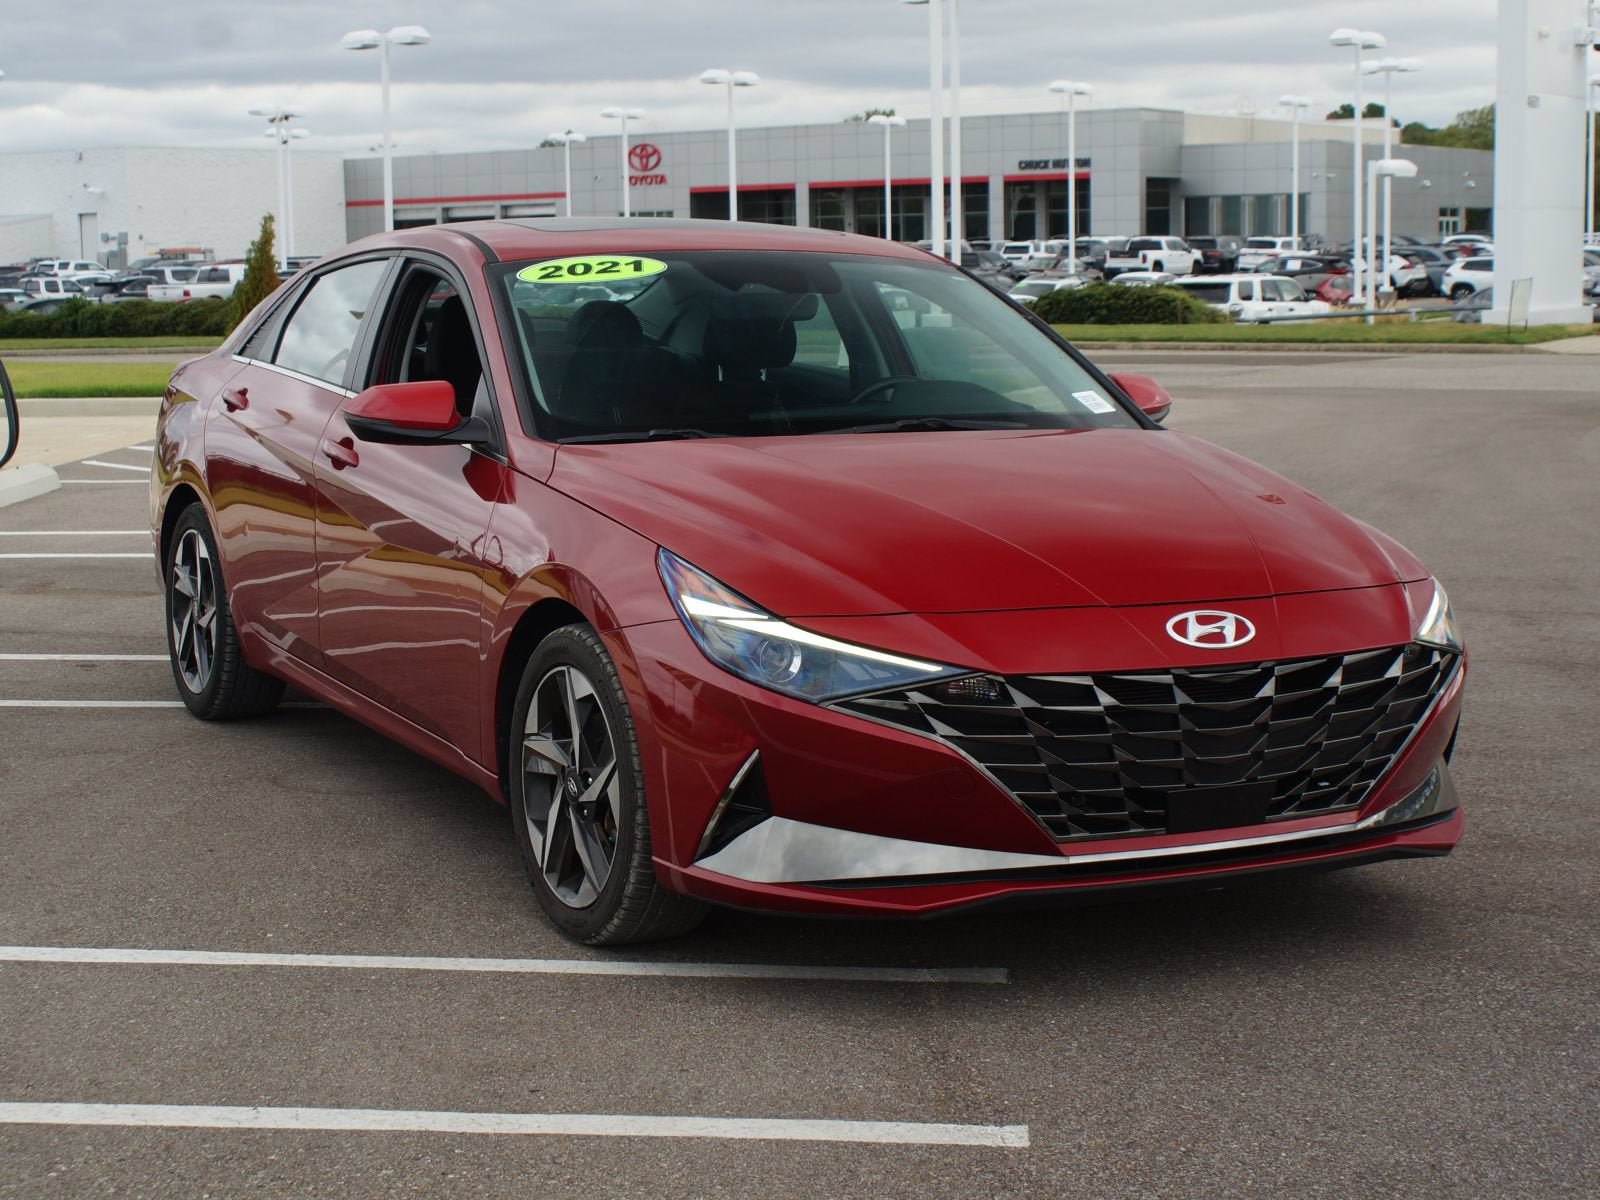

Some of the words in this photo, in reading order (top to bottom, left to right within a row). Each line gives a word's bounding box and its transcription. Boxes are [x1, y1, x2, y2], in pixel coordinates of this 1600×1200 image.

[1018, 160, 1050, 170] CHUCK
[621, 174, 667, 186] OYOTA
[537, 259, 644, 280] 2021
